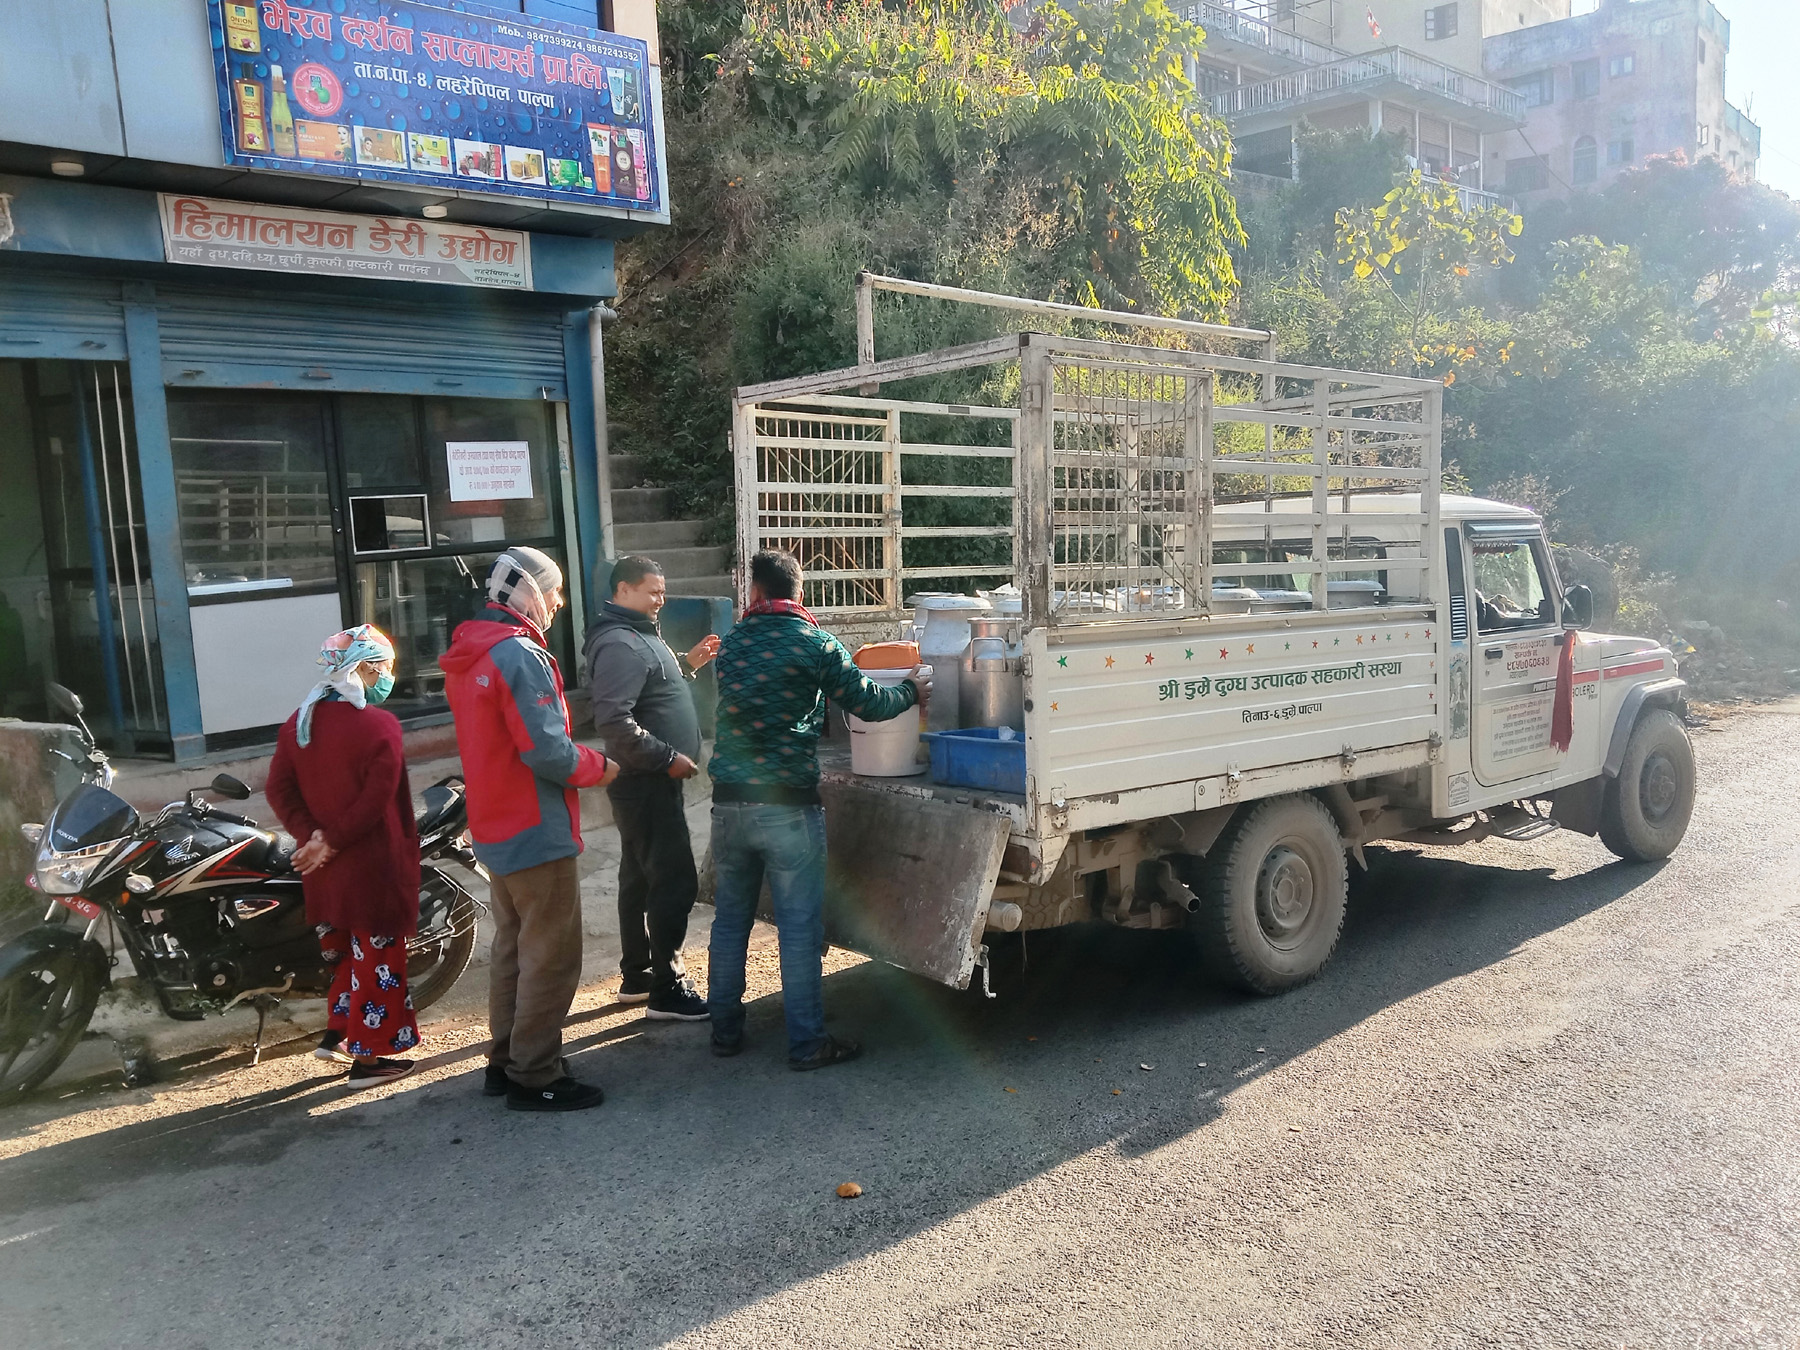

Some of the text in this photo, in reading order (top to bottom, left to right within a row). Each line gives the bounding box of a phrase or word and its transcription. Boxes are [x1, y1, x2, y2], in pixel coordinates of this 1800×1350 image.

[262, 0, 608, 90] भैरव दर्शन सप्लायर्स प्रा.लि.
[497, 25, 524, 38] Mob.
[517, 89, 554, 108] पाल्पा
[173, 198, 518, 266] हिमालयन डेरी उद्योग
[1159, 679, 1180, 701] श्री
[1184, 677, 1212, 700] डुम्रे
[1215, 677, 1248, 697] दुग्ध
[1251, 671, 1308, 691] उत्पादक
[1311, 662, 1365, 684] सहकारी
